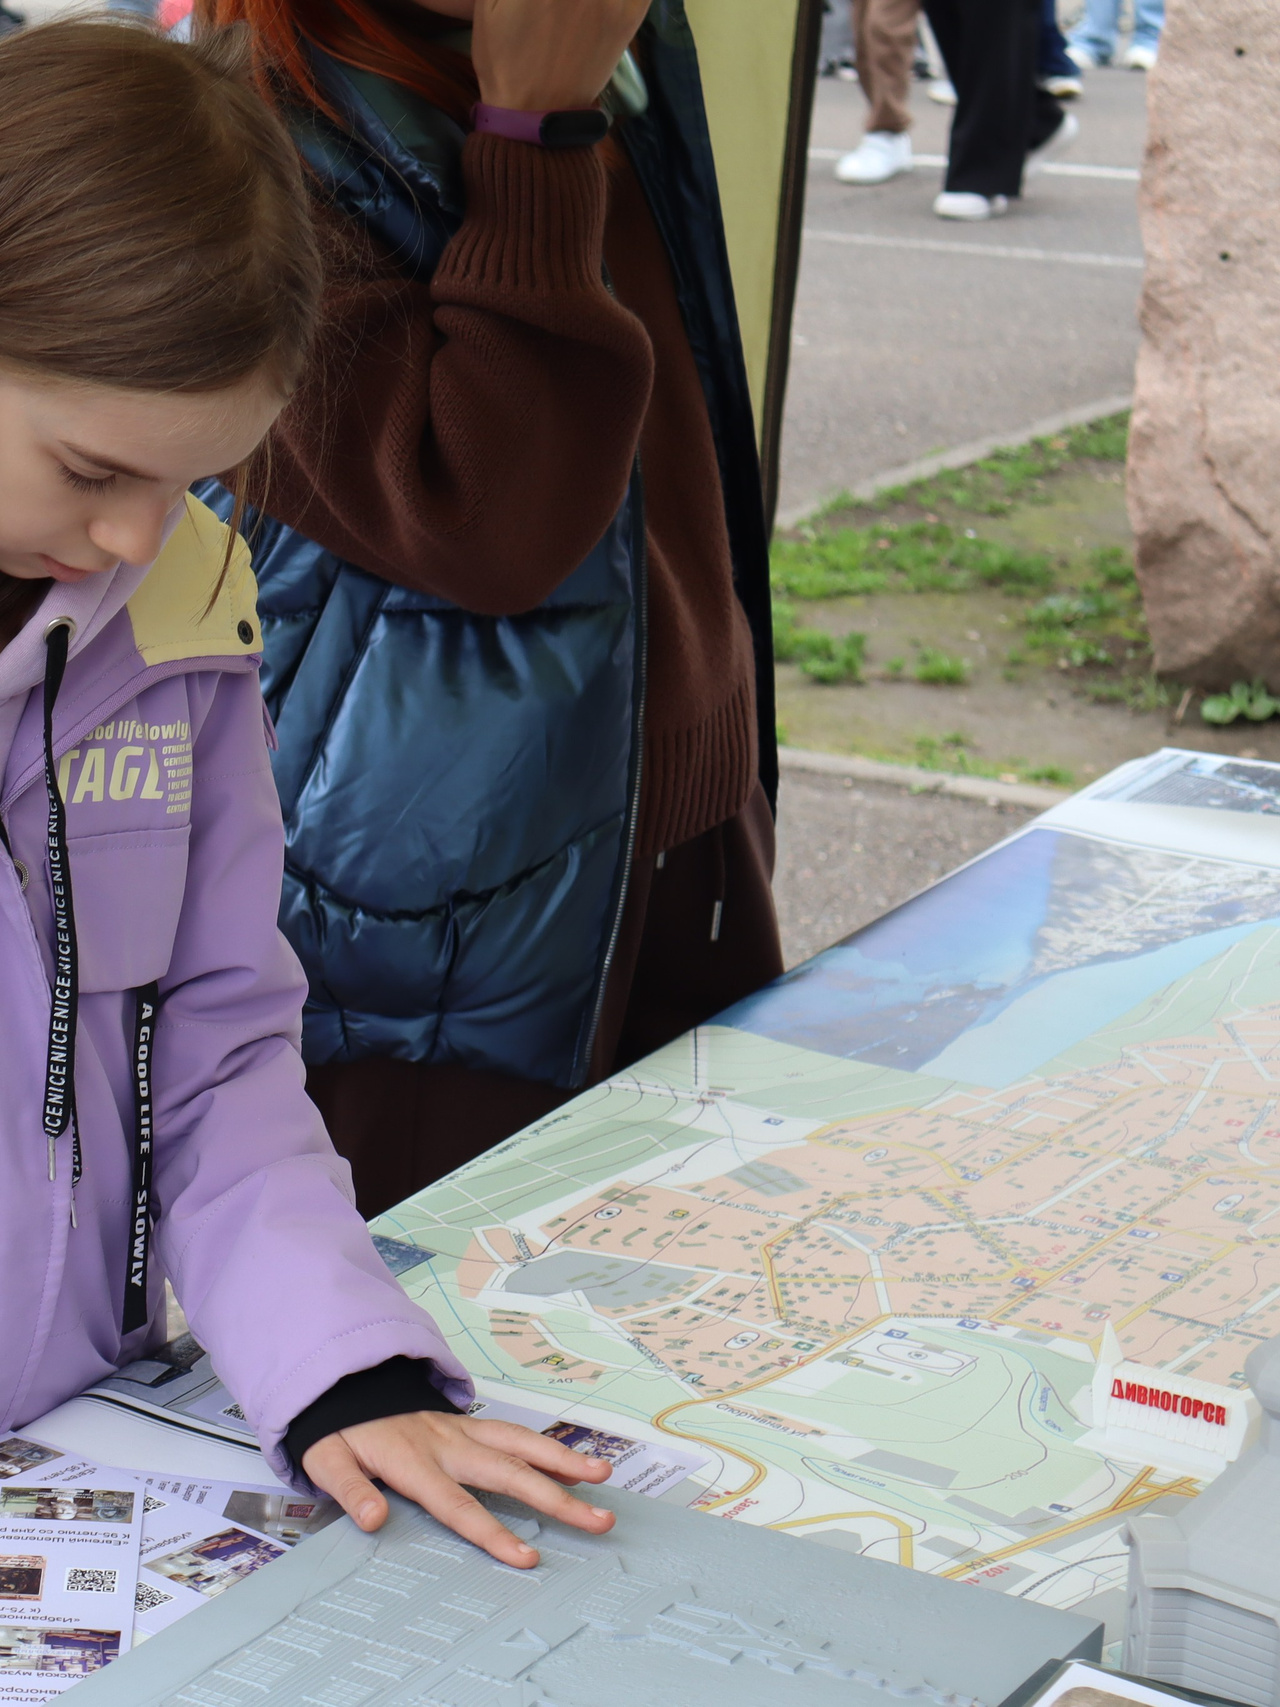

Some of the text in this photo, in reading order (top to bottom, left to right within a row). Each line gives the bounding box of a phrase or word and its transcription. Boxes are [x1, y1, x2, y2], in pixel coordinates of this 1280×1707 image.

[77, 721, 115, 745] ood
[117, 721, 142, 742] life
[142, 1003, 153, 1020] A
[137, 1026, 150, 1097] GOOD
[140, 1104, 150, 1155] LIFE
[131, 1190, 147, 1287] SLOWLY
[716, 1402, 789, 1434] Спортивная
[1111, 1378, 1227, 1426] ДИВНОГОРСК
[58, 1530, 119, 1539] 95-летию
[67, 1536, 130, 1547] «Евгений
